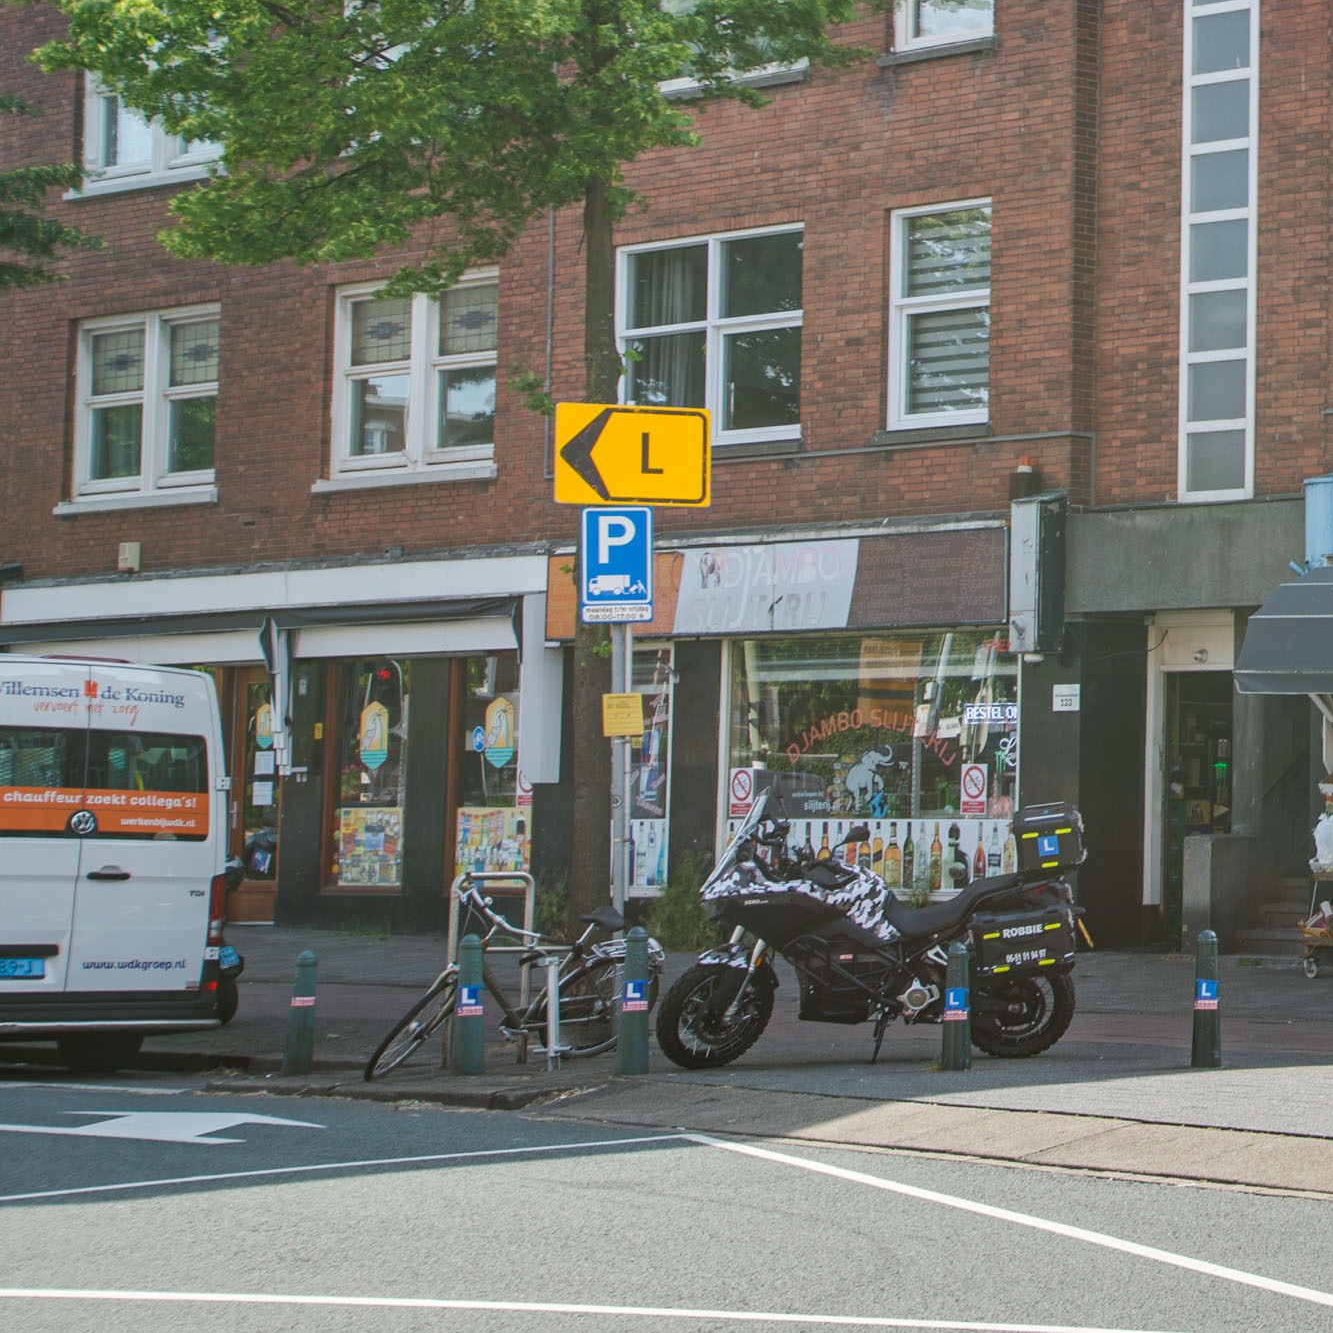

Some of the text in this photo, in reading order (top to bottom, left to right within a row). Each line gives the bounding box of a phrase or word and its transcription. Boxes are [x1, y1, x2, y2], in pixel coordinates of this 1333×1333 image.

[641, 432, 664, 474] L
[598, 516, 636, 564] P
[101, 686, 121, 700] de
[125, 688, 185, 708] Koning
[1060, 698, 1073, 707] 123
[966, 706, 1005, 720] BESTEL
[785, 708, 863, 765] DJAMBO
[3, 791, 197, 810] chauffeur zoekt collega's!
[1044, 839, 1055, 852] L
[1002, 923, 1044, 939] ROBBIE
[82, 959, 187, 972] www.wdkgroep.nl
[462, 987, 475, 1004] L
[627, 983, 641, 999] L
[1201, 982, 1212, 997] L
[949, 991, 960, 1006] L
